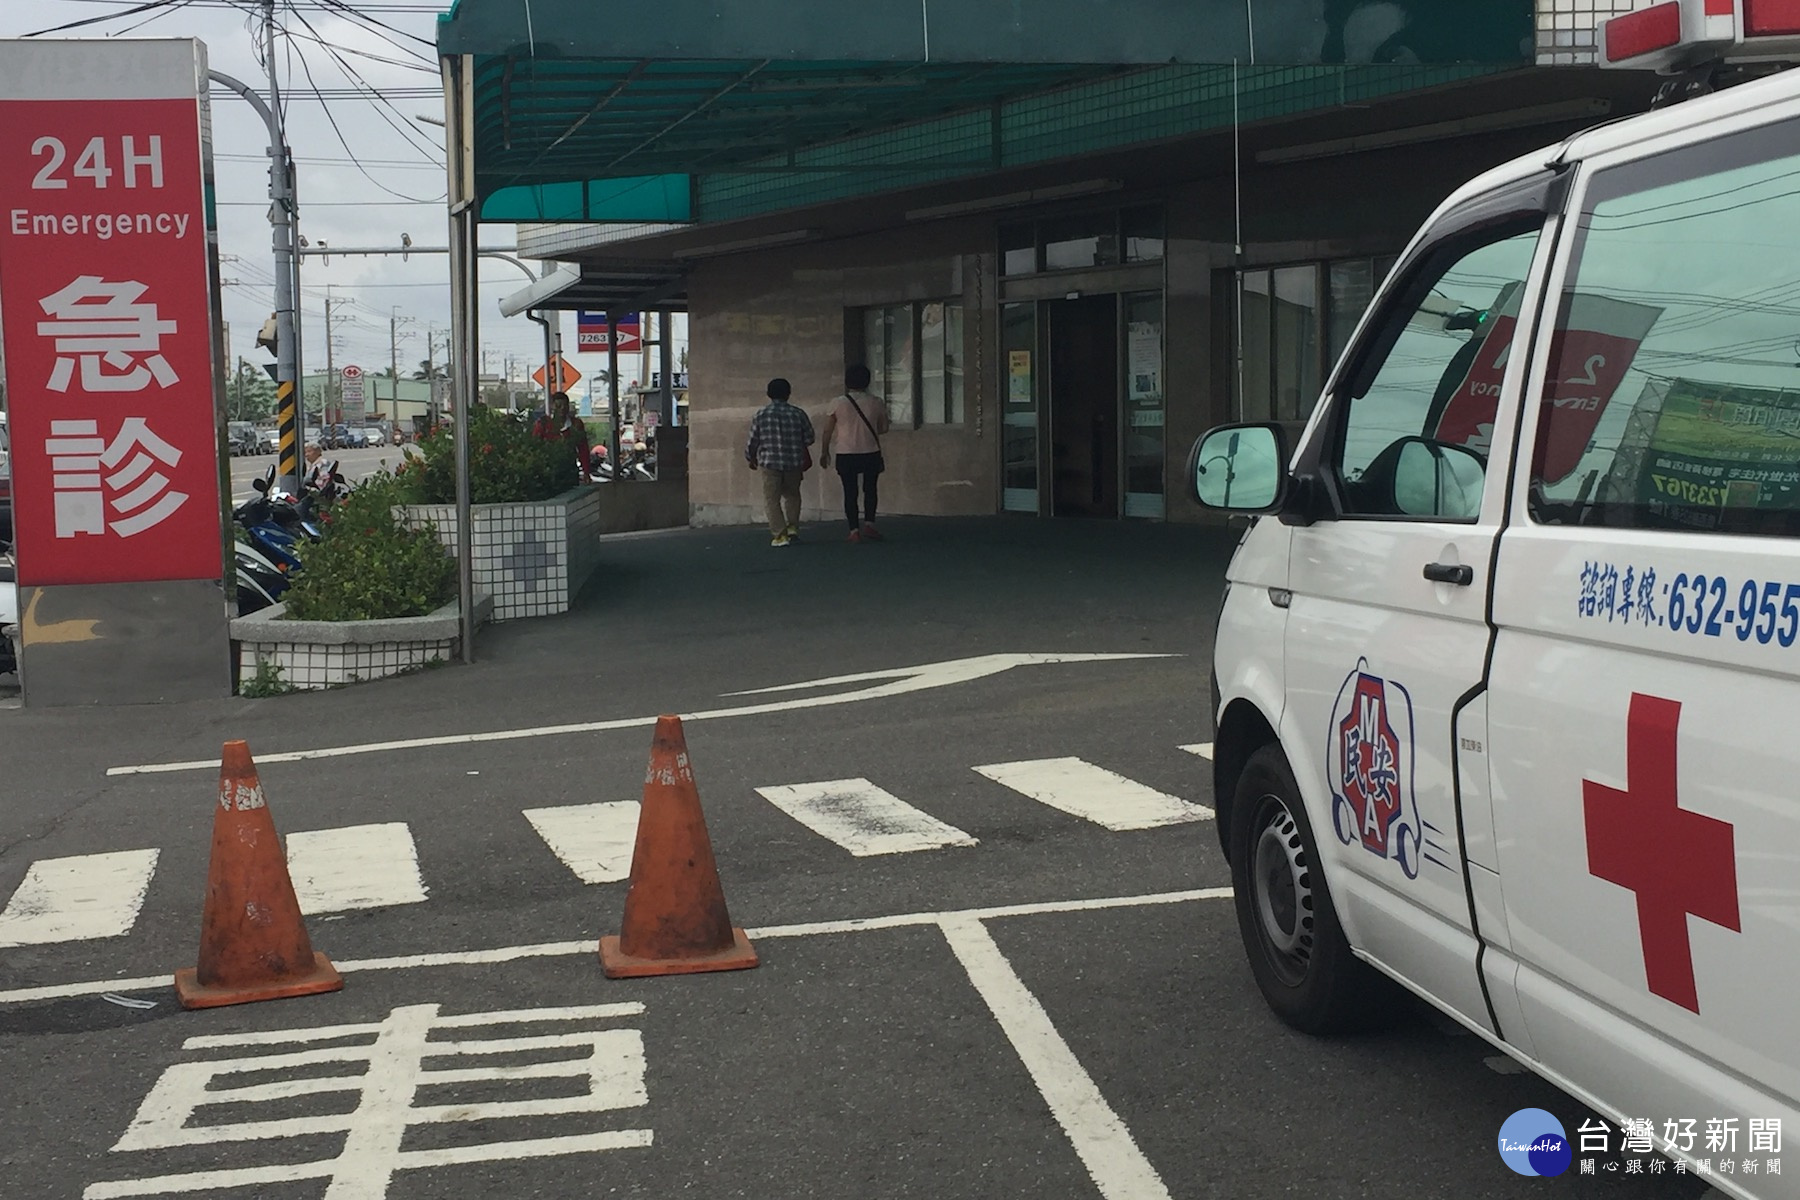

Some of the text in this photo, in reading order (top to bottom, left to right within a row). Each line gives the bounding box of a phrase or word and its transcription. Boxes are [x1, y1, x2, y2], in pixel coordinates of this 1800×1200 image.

[32, 135, 164, 189] 24H
[11, 209, 189, 240] Emergency
[37, 275, 190, 538] 急診
[1360, 693, 1380, 747] M
[1364, 792, 1383, 843] A
